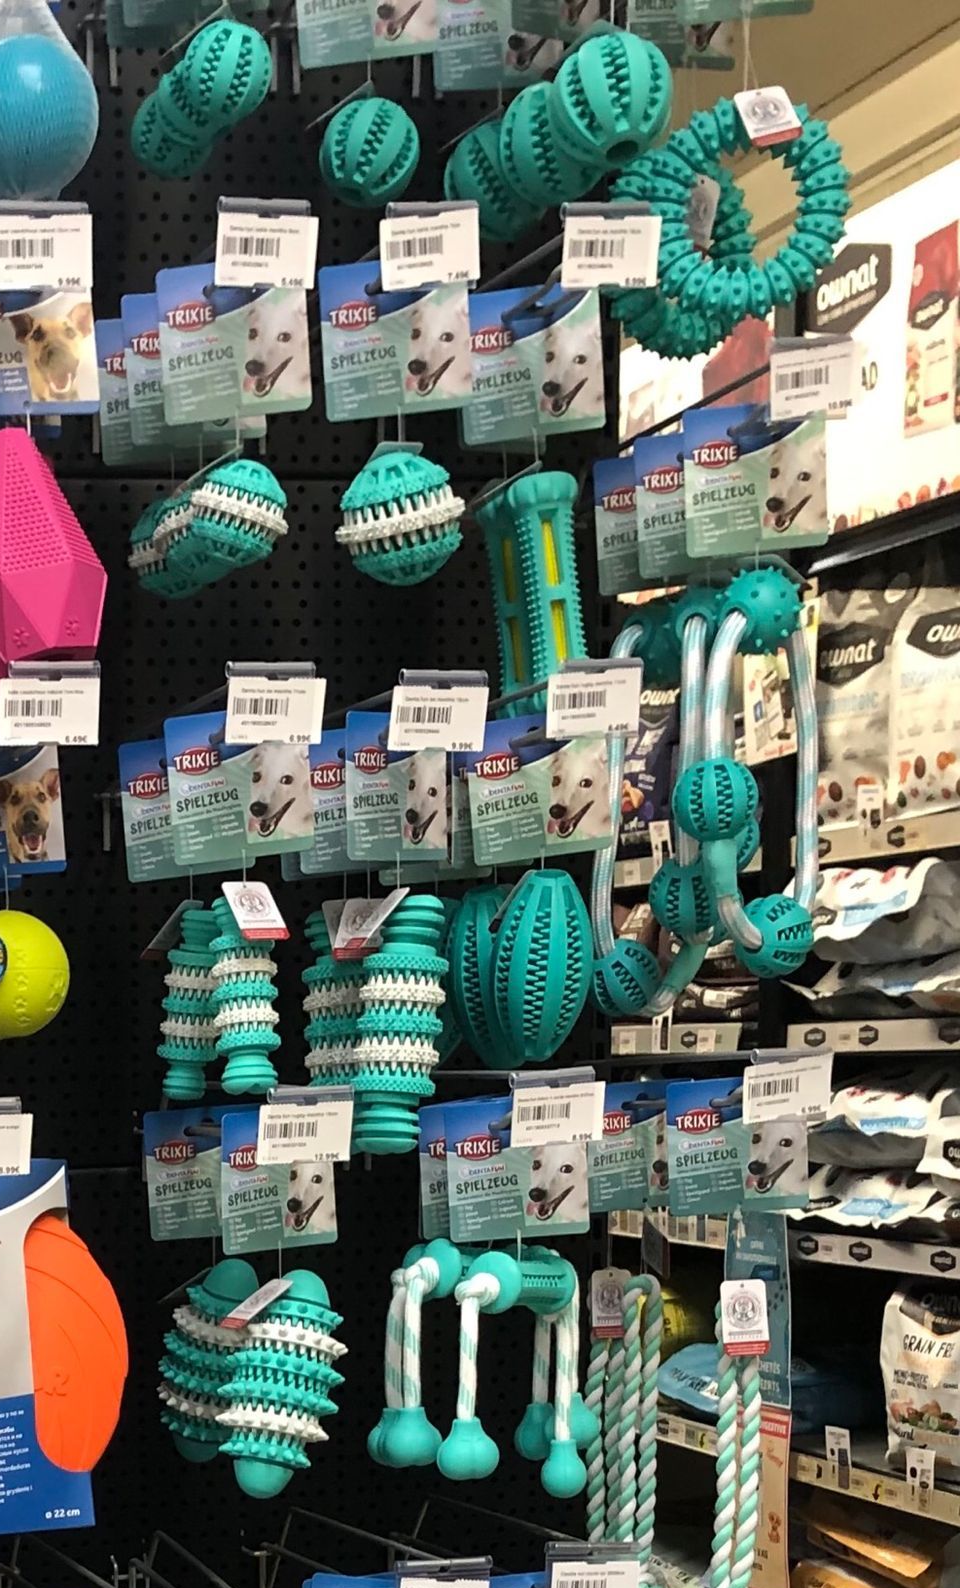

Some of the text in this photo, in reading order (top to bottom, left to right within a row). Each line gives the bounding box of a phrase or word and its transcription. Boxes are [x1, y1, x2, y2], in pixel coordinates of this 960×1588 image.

[440, 20, 498, 40] SPIELZEUG
[817, 254, 879, 311] ownat
[166, 307, 213, 328] TRIXIE
[330, 305, 377, 326] TRIXIE
[168, 348, 233, 371] SPIELZEUG
[331, 345, 396, 370] SPIELZEUG
[693, 443, 738, 464] TRIXIE
[693, 482, 756, 505] SPIELZEUG
[173, 751, 220, 771] TRIXIE
[354, 753, 386, 767] TRIXIE
[475, 758, 519, 775] TRIXIE
[176, 789, 239, 812] SPIELZEUG
[353, 793, 399, 810] SPIELZEUG
[477, 793, 538, 816] SPIELZEUG
[676, 1111, 720, 1131] TRIXIE
[154, 1144, 195, 1160] TRIXIE
[455, 1137, 501, 1156] TRIXIE
[593, 1148, 645, 1167] SPIELZEUG
[676, 1147, 738, 1168] SPIELZEUG
[155, 1178, 213, 1196] SPIELZEUG
[456, 1175, 519, 1195] SPIELZEUG
[228, 1186, 279, 1207] SPIELZEUG
[903, 1334, 934, 1355] GRAIN
[54, 1509, 66, 1518] 22
[67, 1508, 81, 1517] cm
